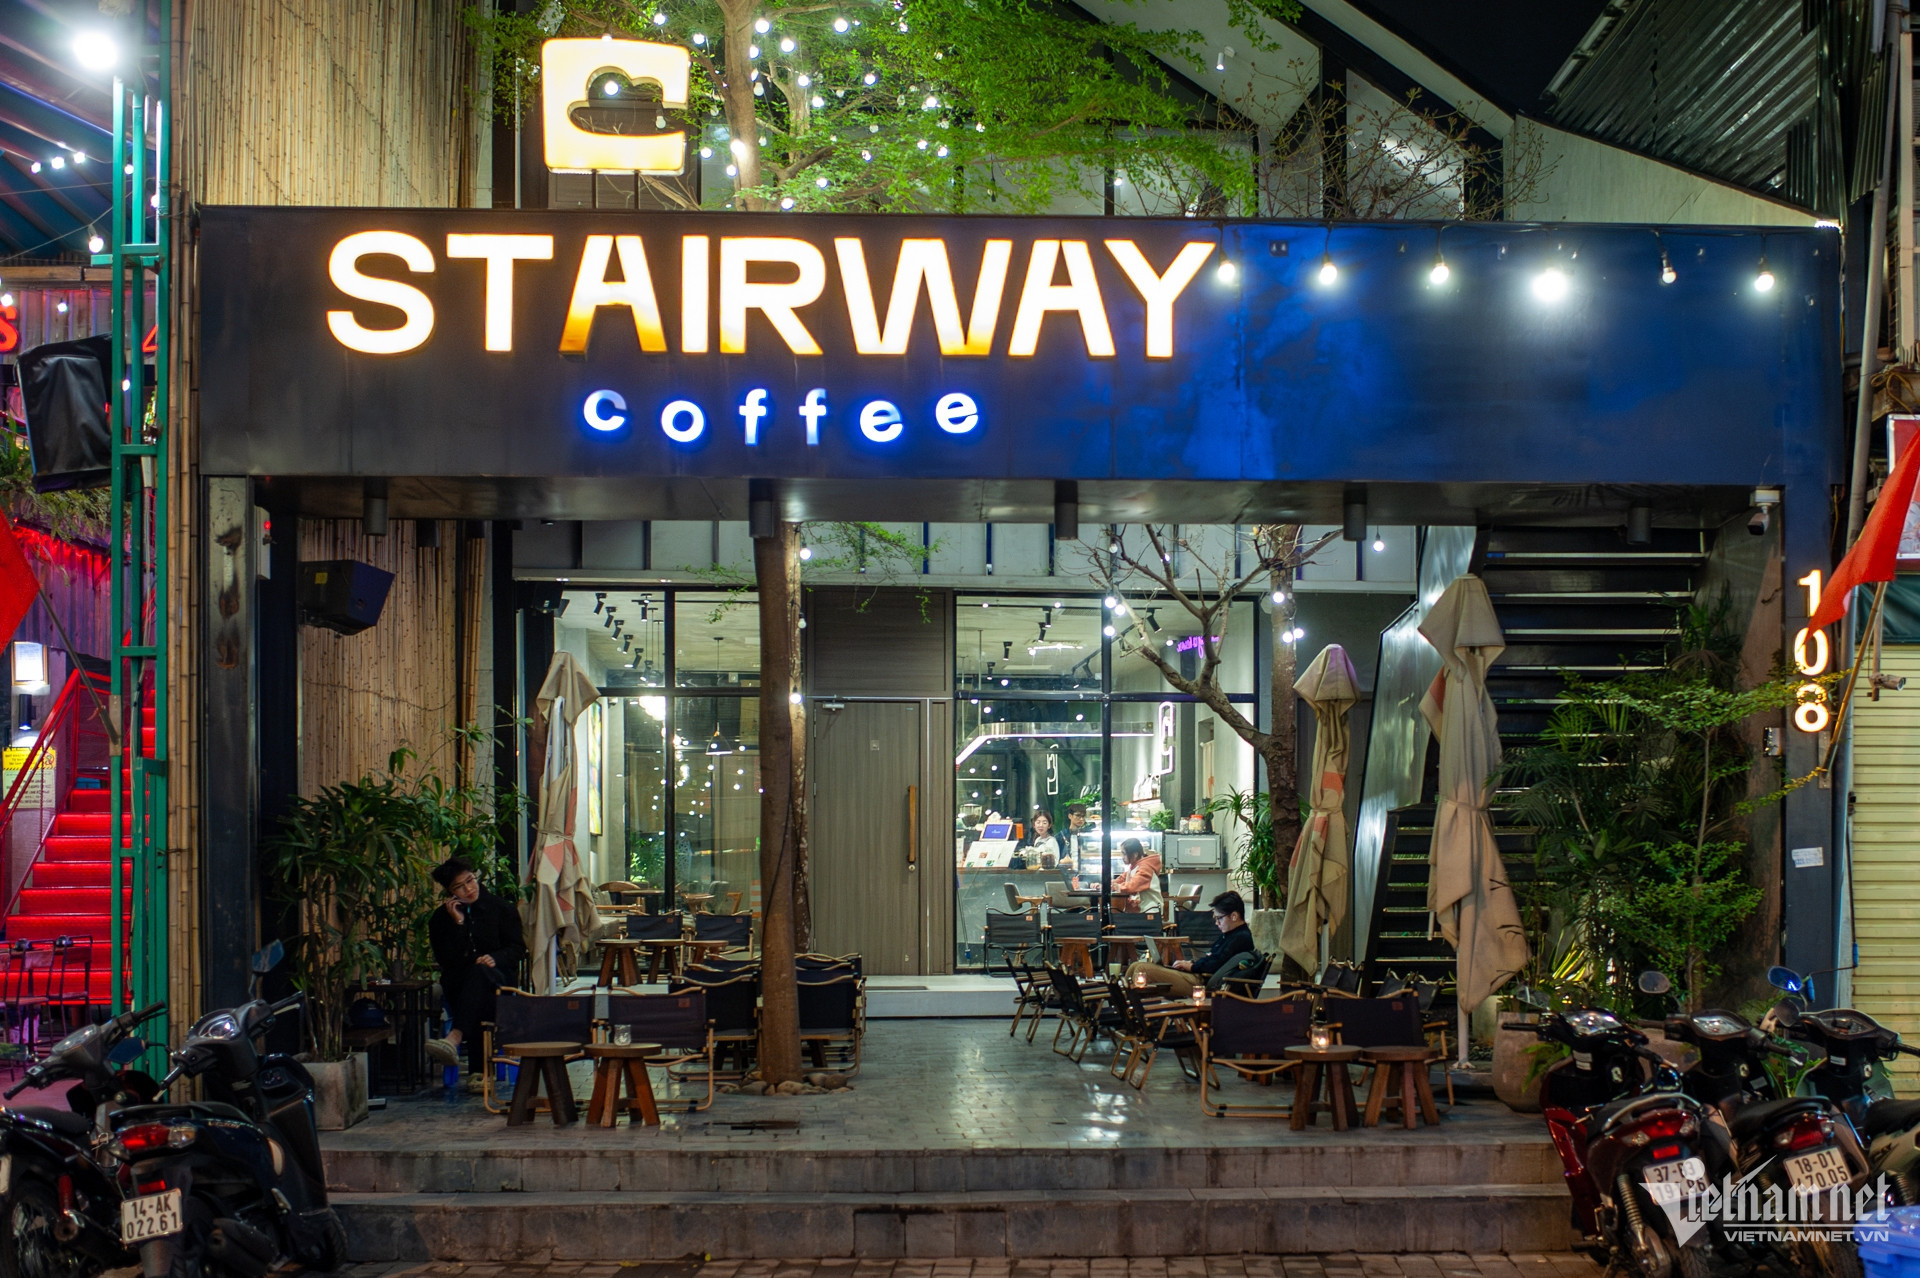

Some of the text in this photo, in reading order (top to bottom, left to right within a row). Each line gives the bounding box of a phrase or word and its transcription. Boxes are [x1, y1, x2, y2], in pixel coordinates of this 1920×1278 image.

[326, 230, 1215, 359] STAIRWAY
[583, 387, 979, 446] coffee
[1794, 569, 1830, 733] 108
[1795, 1150, 1836, 1174] 18-D1
[126, 1212, 178, 1239] 022.61
[131, 1194, 172, 1219] 14-AK
